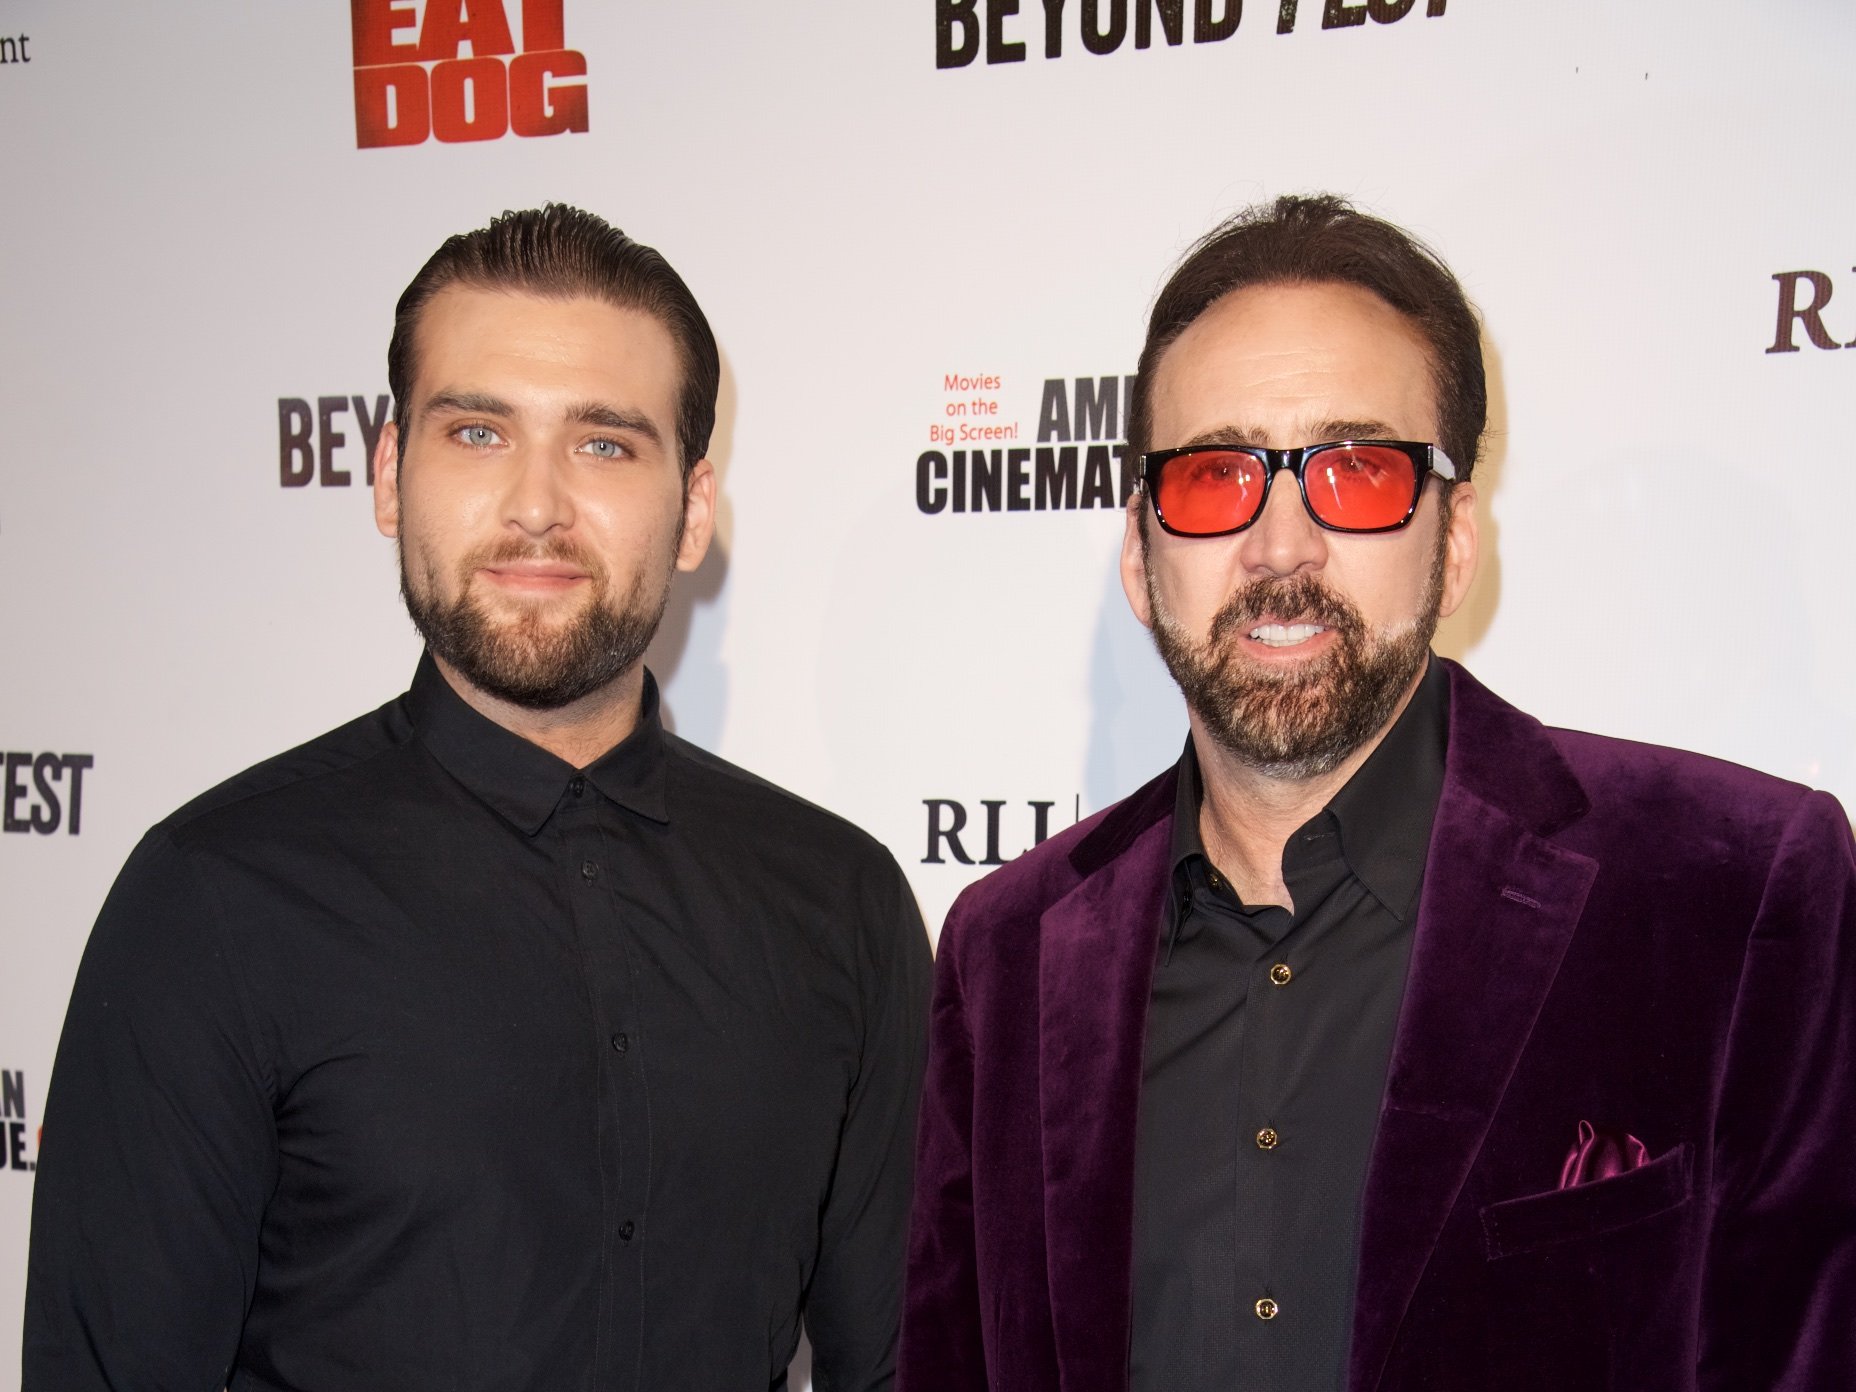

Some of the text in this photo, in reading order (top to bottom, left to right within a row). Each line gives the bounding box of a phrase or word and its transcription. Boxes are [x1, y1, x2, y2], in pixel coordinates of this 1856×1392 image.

[0, 32, 31, 64] nt
[353, 49, 589, 150] DOG
[1765, 266, 1856, 354] R
[944, 374, 1001, 391] Movies
[946, 397, 998, 417] on the
[278, 394, 396, 488] BEY
[930, 421, 1019, 446] Big Screen!
[0, 752, 94, 836] EST
[0, 1069, 25, 1119] N
